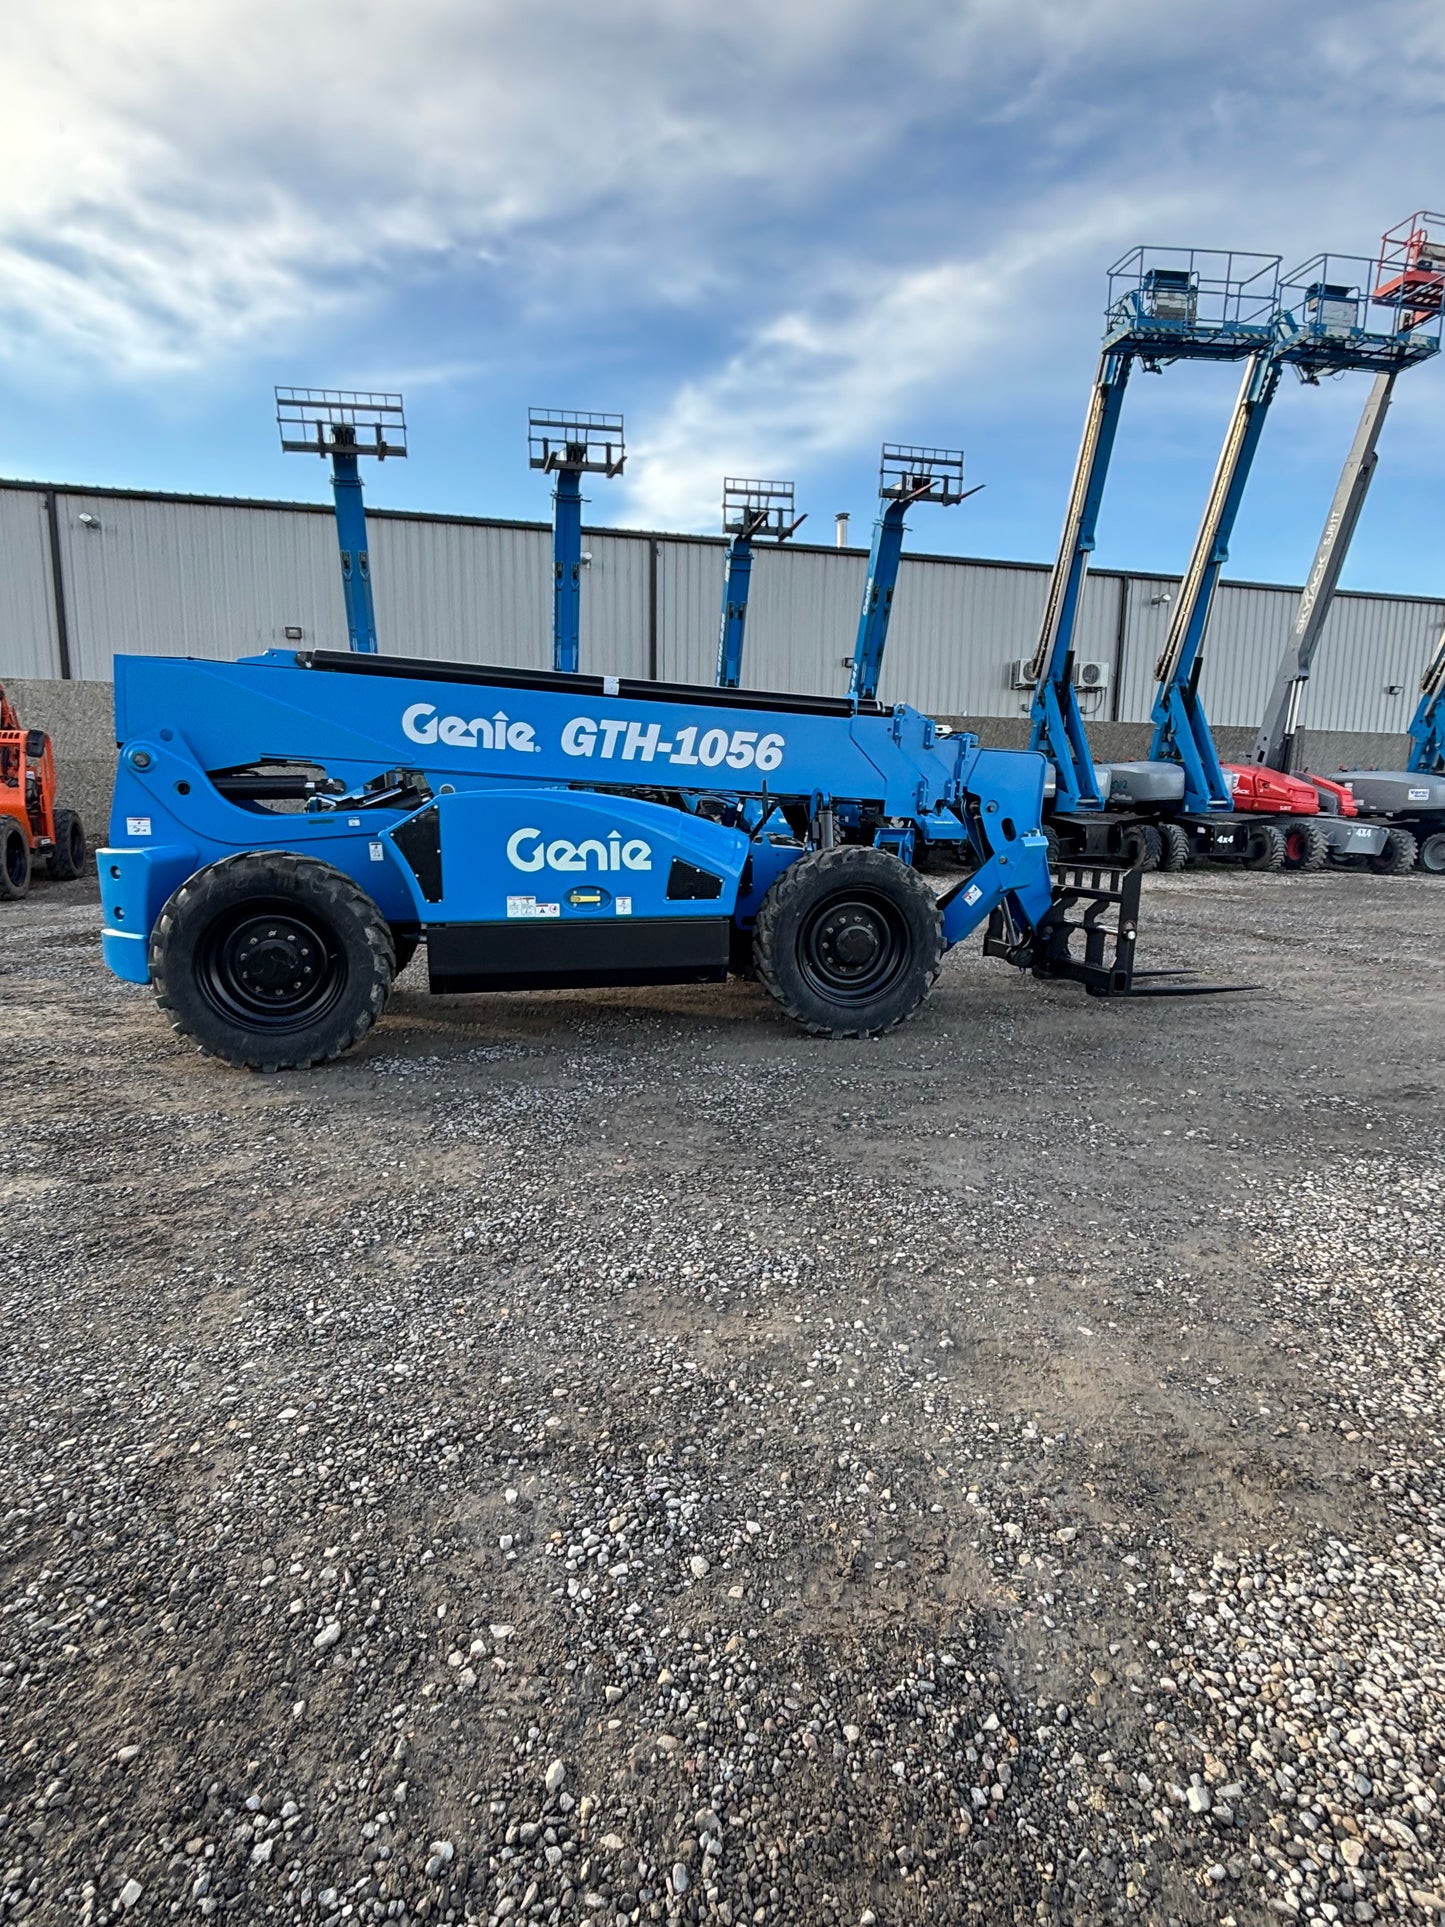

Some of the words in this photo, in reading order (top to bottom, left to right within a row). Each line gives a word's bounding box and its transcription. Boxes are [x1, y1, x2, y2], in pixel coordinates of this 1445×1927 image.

[1296, 555, 1328, 634] SKYJACK
[402, 703, 537, 752] Genie
[560, 716, 785, 771] GTH-1056
[506, 827, 652, 872] Genie
[1216, 834, 1234, 844] 4x4
